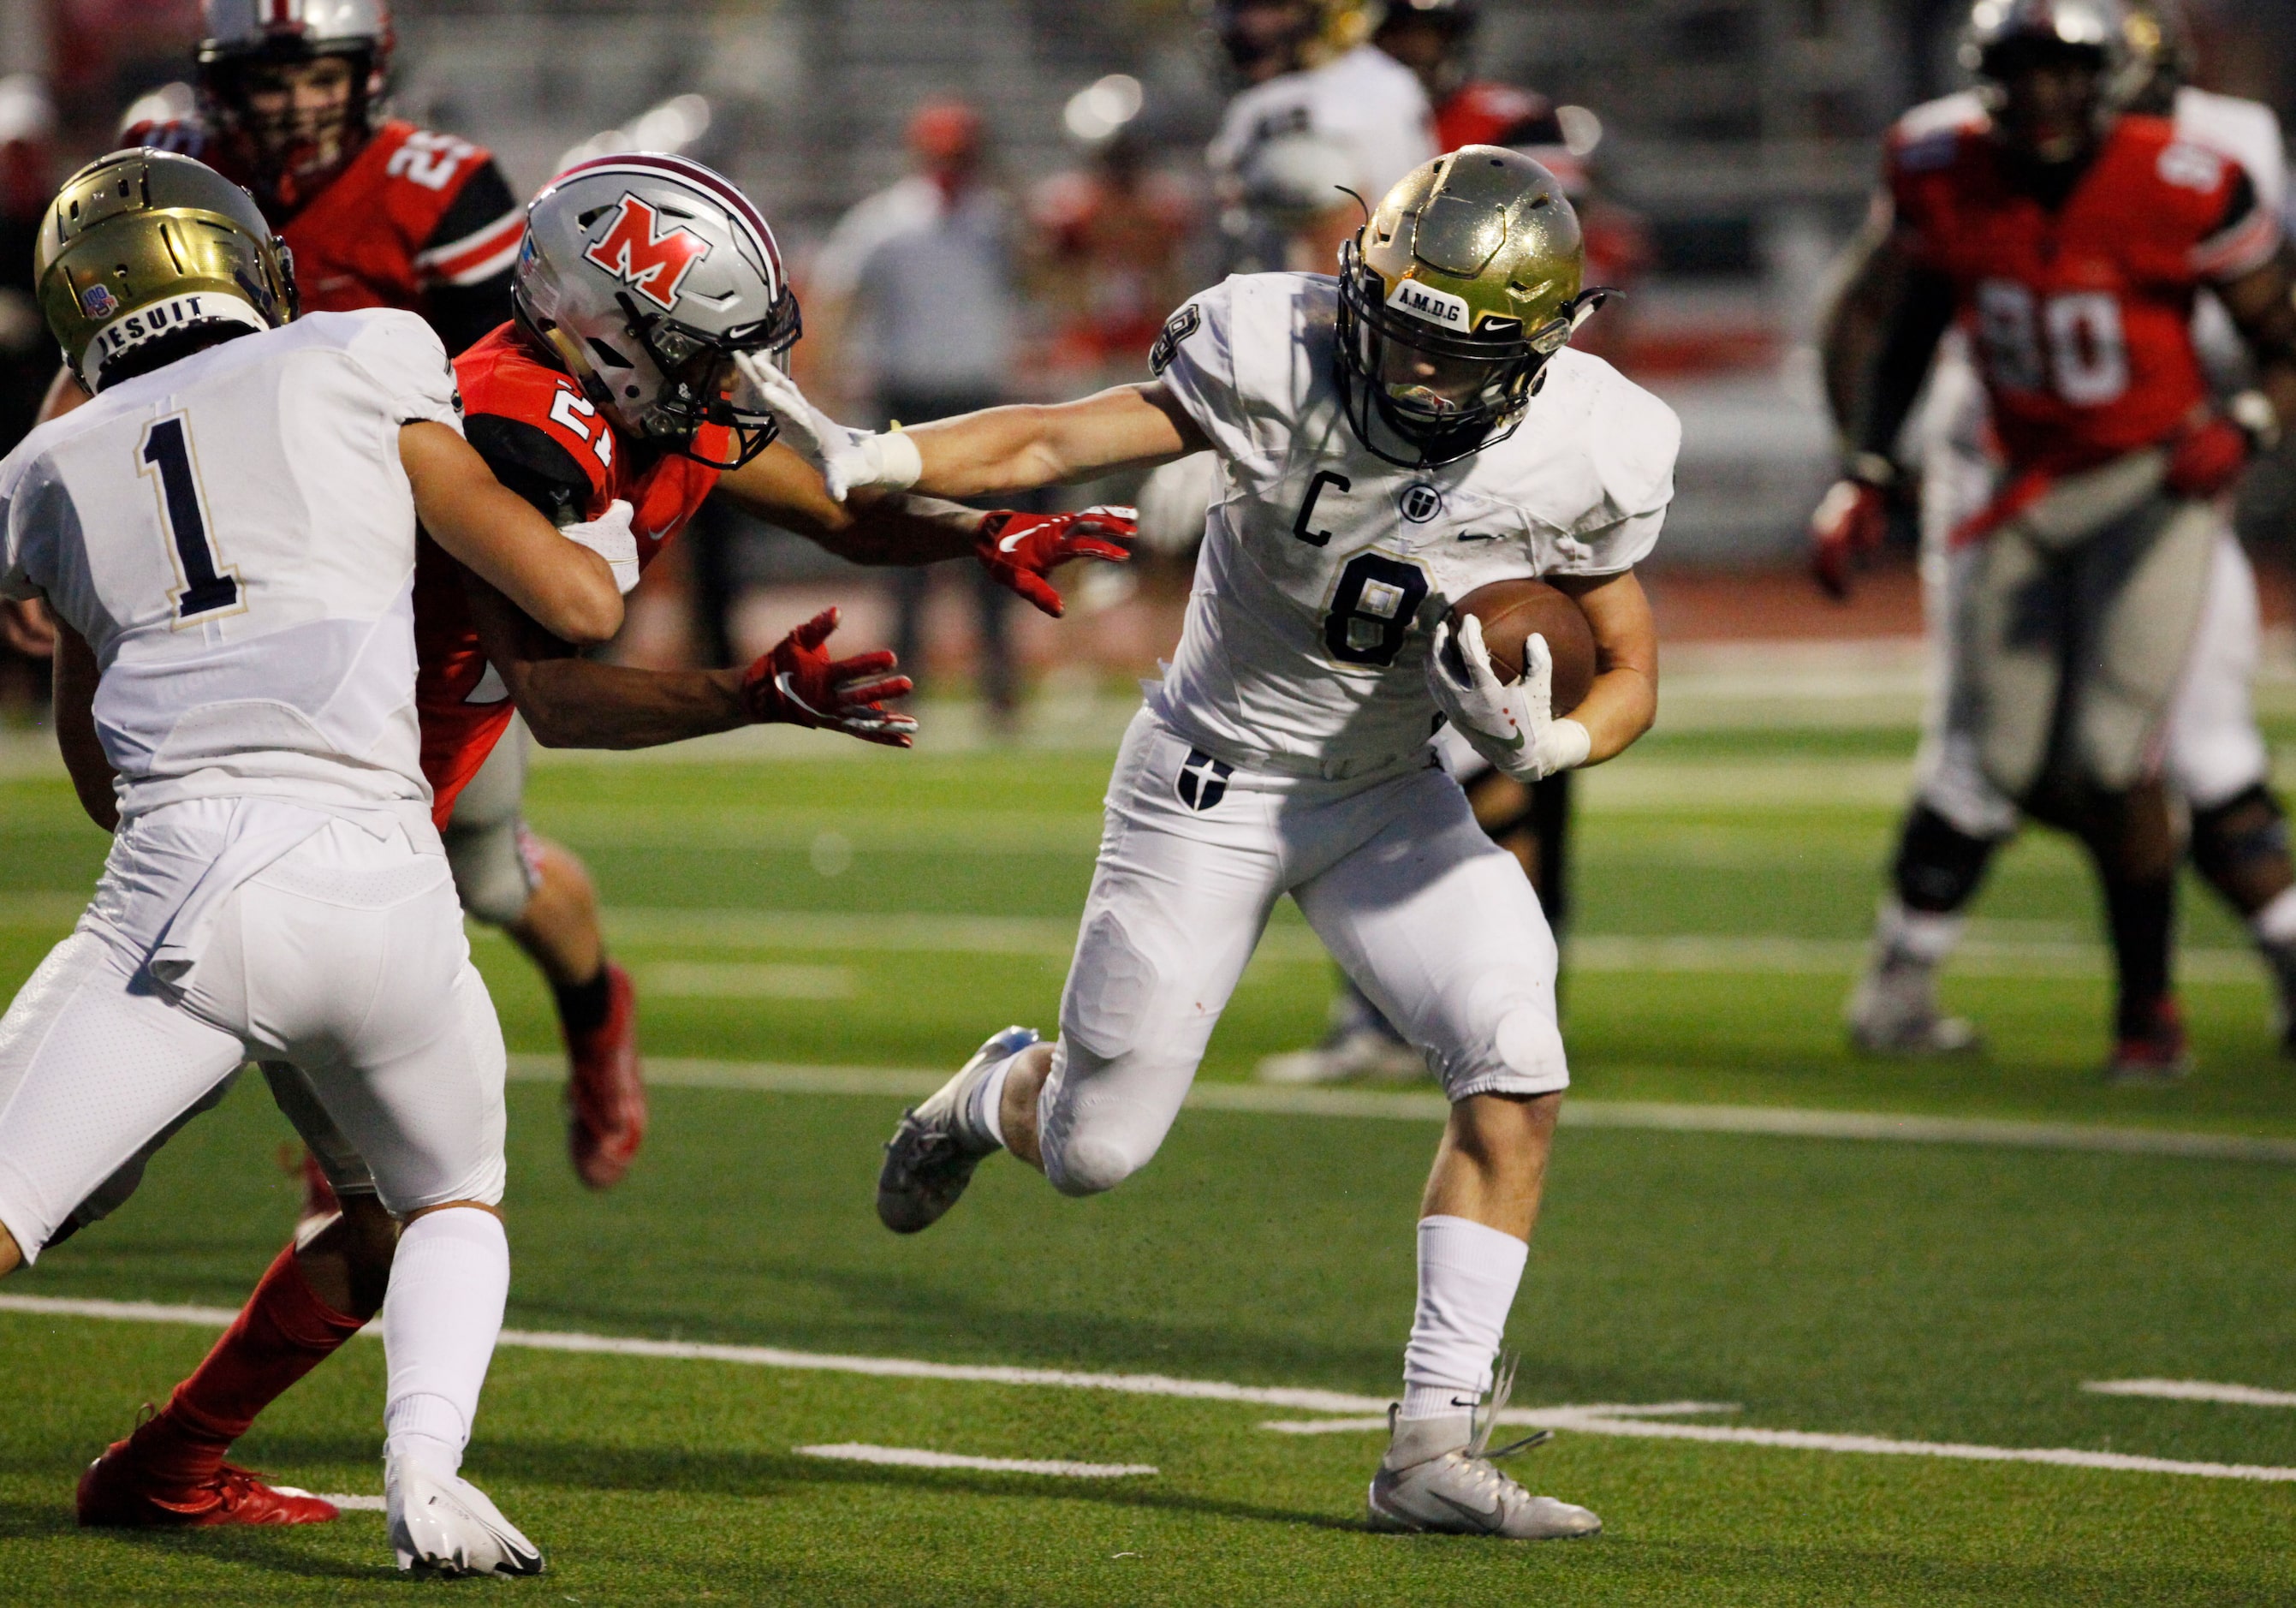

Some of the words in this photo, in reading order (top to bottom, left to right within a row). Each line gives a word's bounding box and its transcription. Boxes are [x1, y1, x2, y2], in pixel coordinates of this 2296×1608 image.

[582, 190, 714, 314] M
[97, 296, 201, 358] JESUIT
[1399, 288, 1460, 321] A.M.D.G
[134, 408, 247, 629] 1
[1293, 470, 1351, 547] C
[1318, 545, 1437, 670] 8
